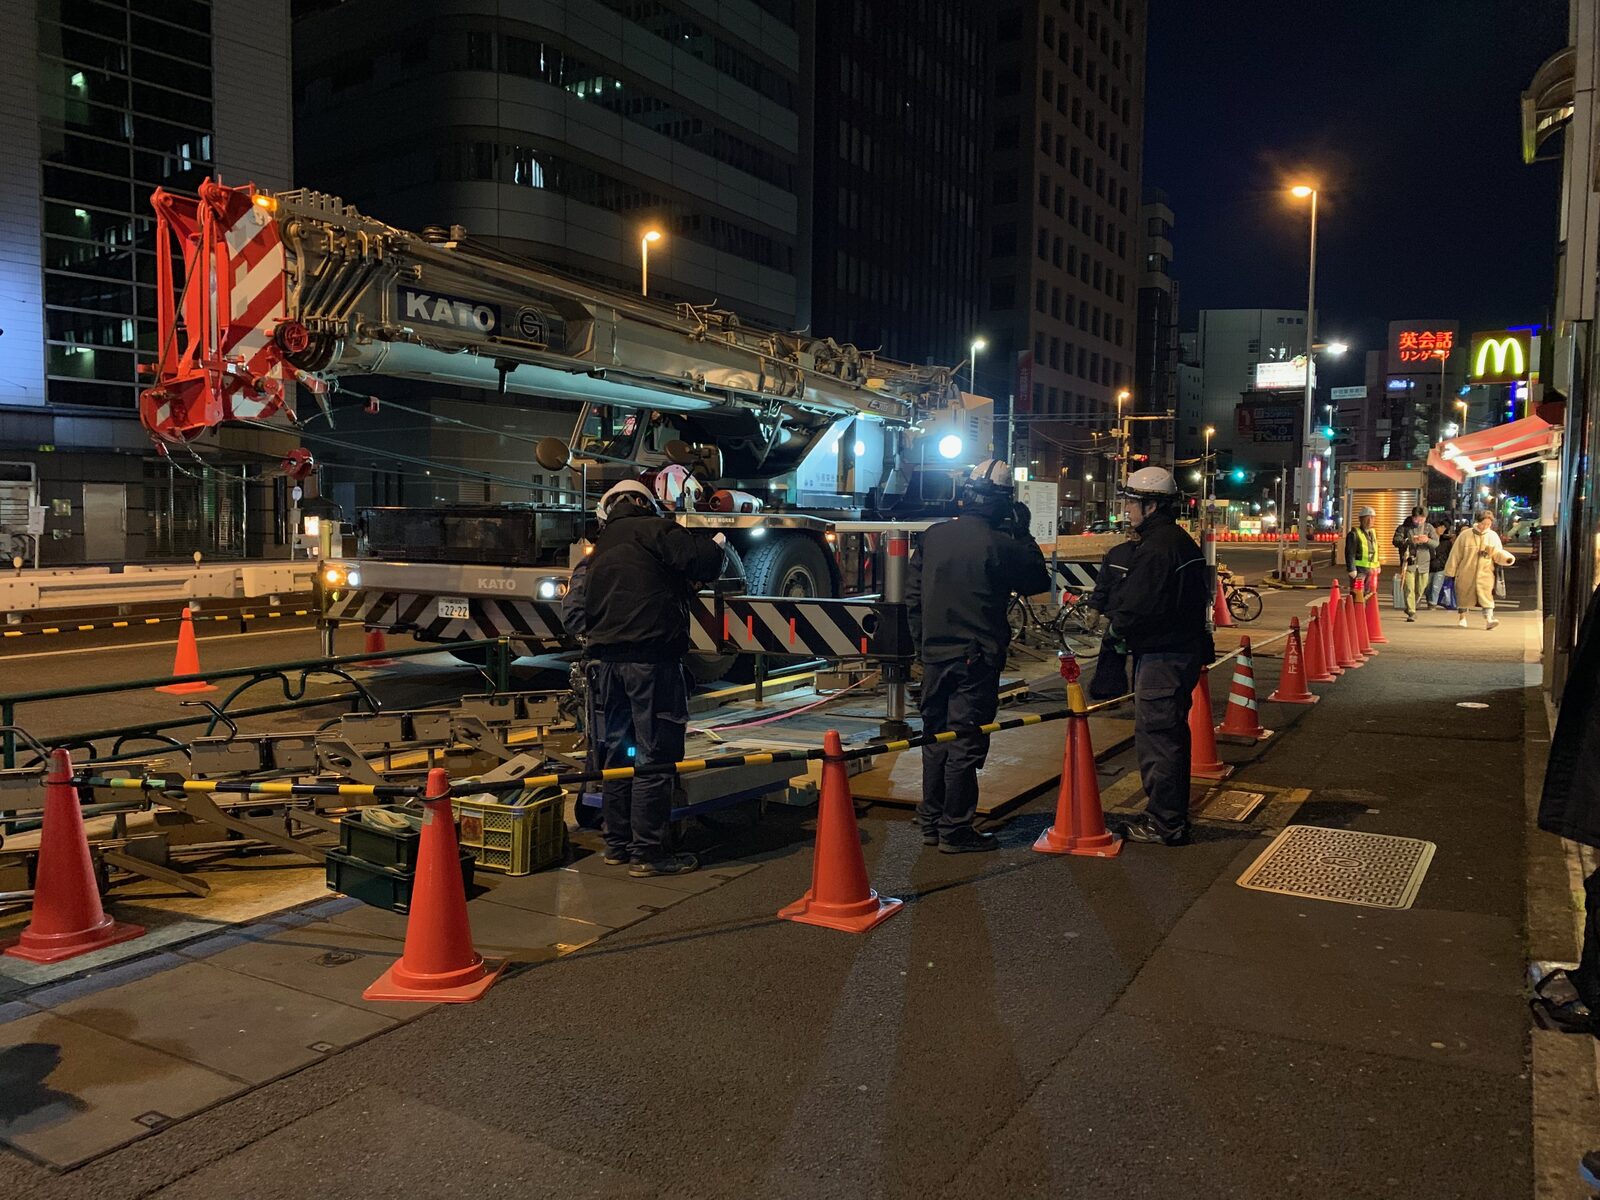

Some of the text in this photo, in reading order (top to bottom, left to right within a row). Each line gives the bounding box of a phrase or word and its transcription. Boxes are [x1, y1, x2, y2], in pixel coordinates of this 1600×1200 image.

[406, 291, 496, 332] KATO
[1399, 331, 1453, 349] 英会話
[478, 578, 516, 590] KATO
